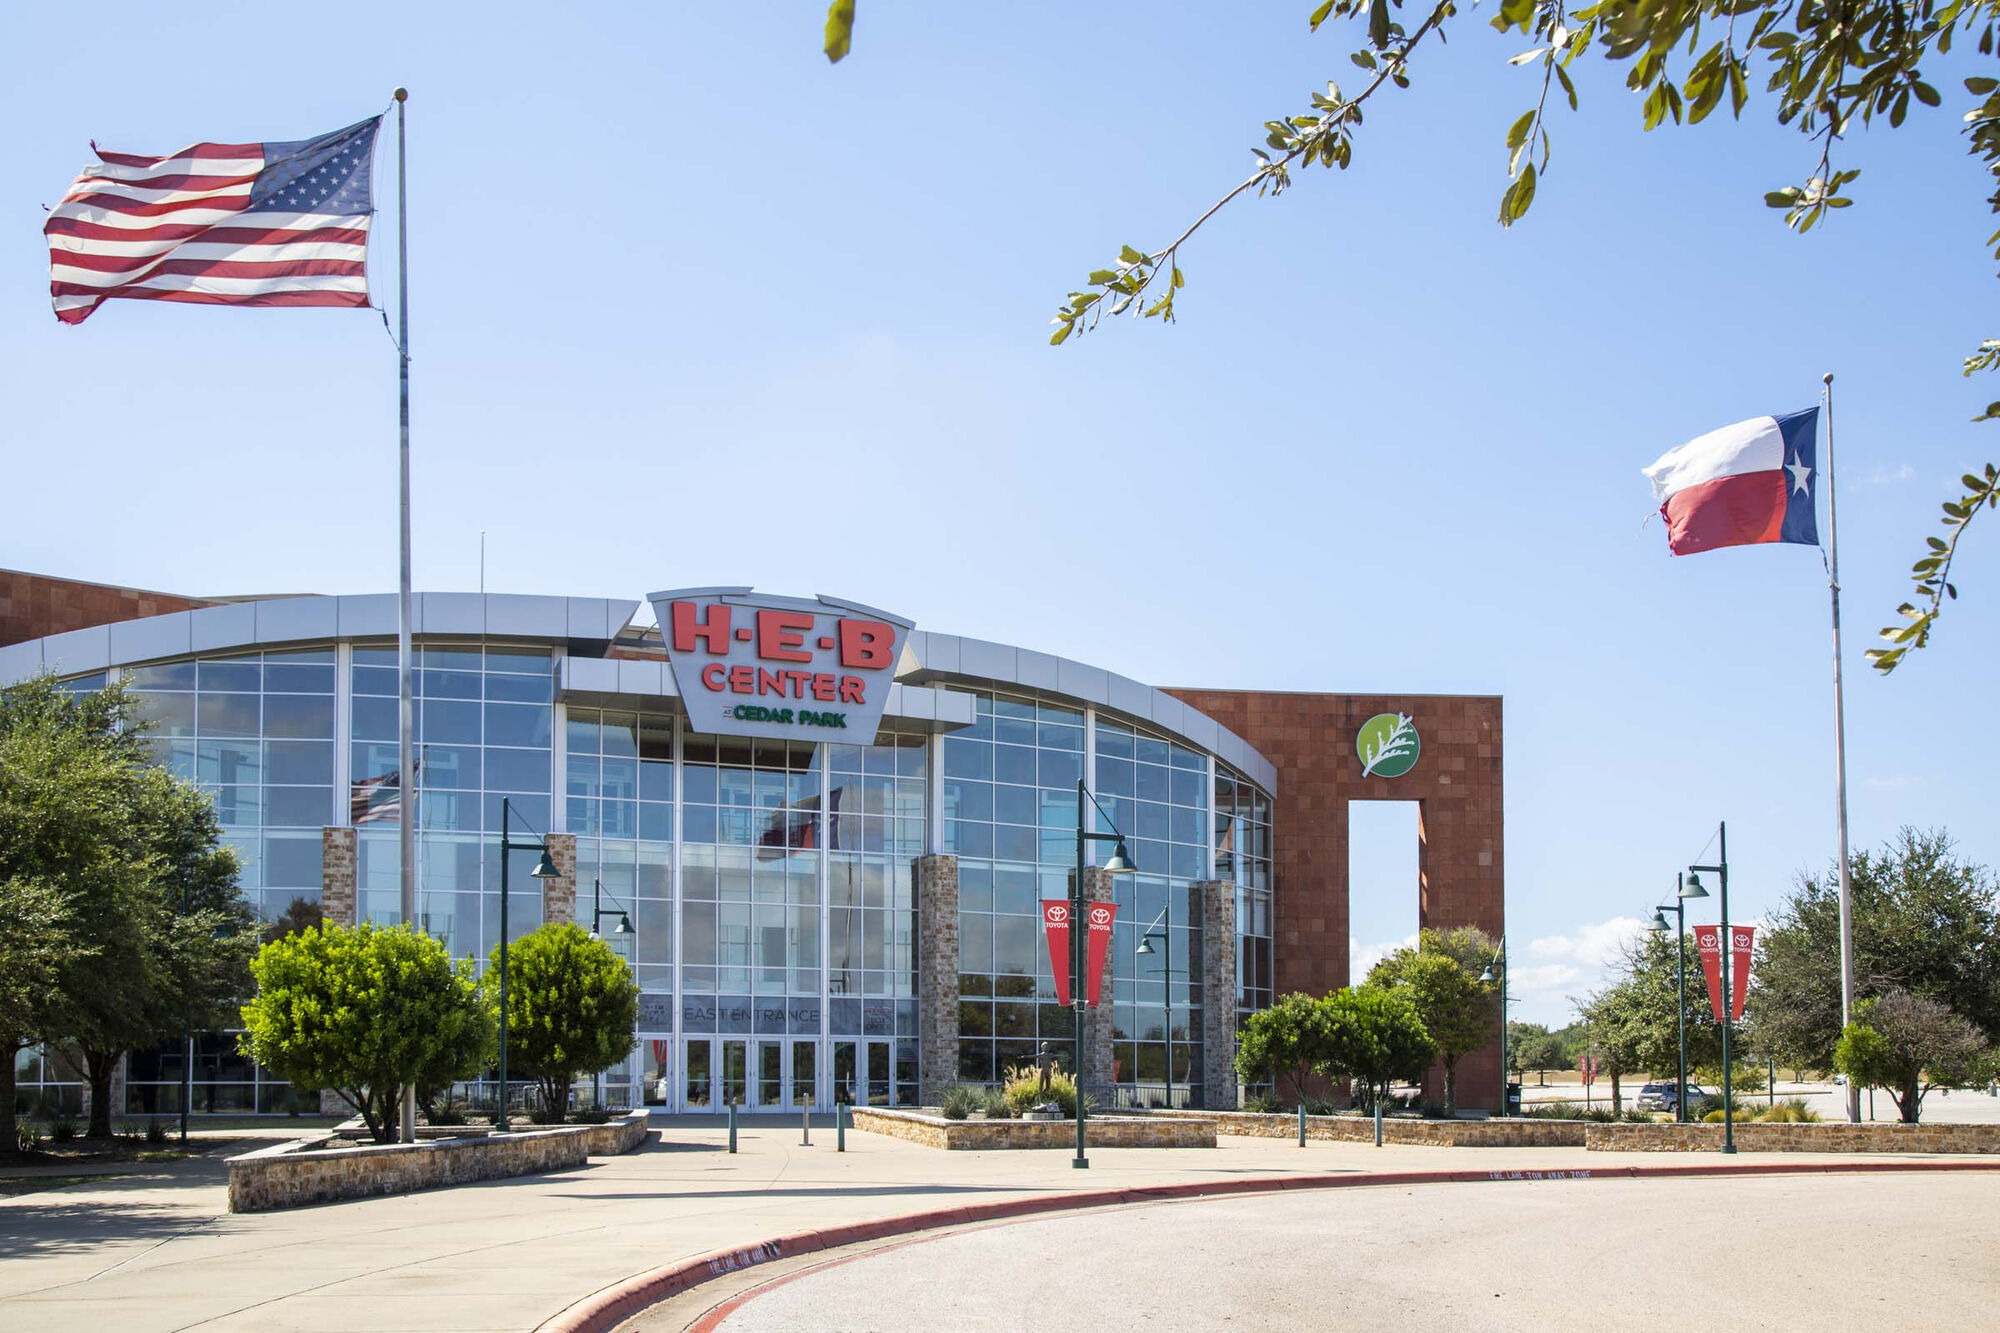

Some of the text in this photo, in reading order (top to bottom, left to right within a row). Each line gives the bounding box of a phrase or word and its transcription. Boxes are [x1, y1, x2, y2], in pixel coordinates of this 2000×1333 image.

[702, 663, 866, 704] CENTER
[734, 705, 794, 725] CEDAR
[799, 709, 847, 729] PARK
[1089, 923, 1111, 931] TOYOTA
[684, 1007, 821, 1023] EAST ENTRANCE
